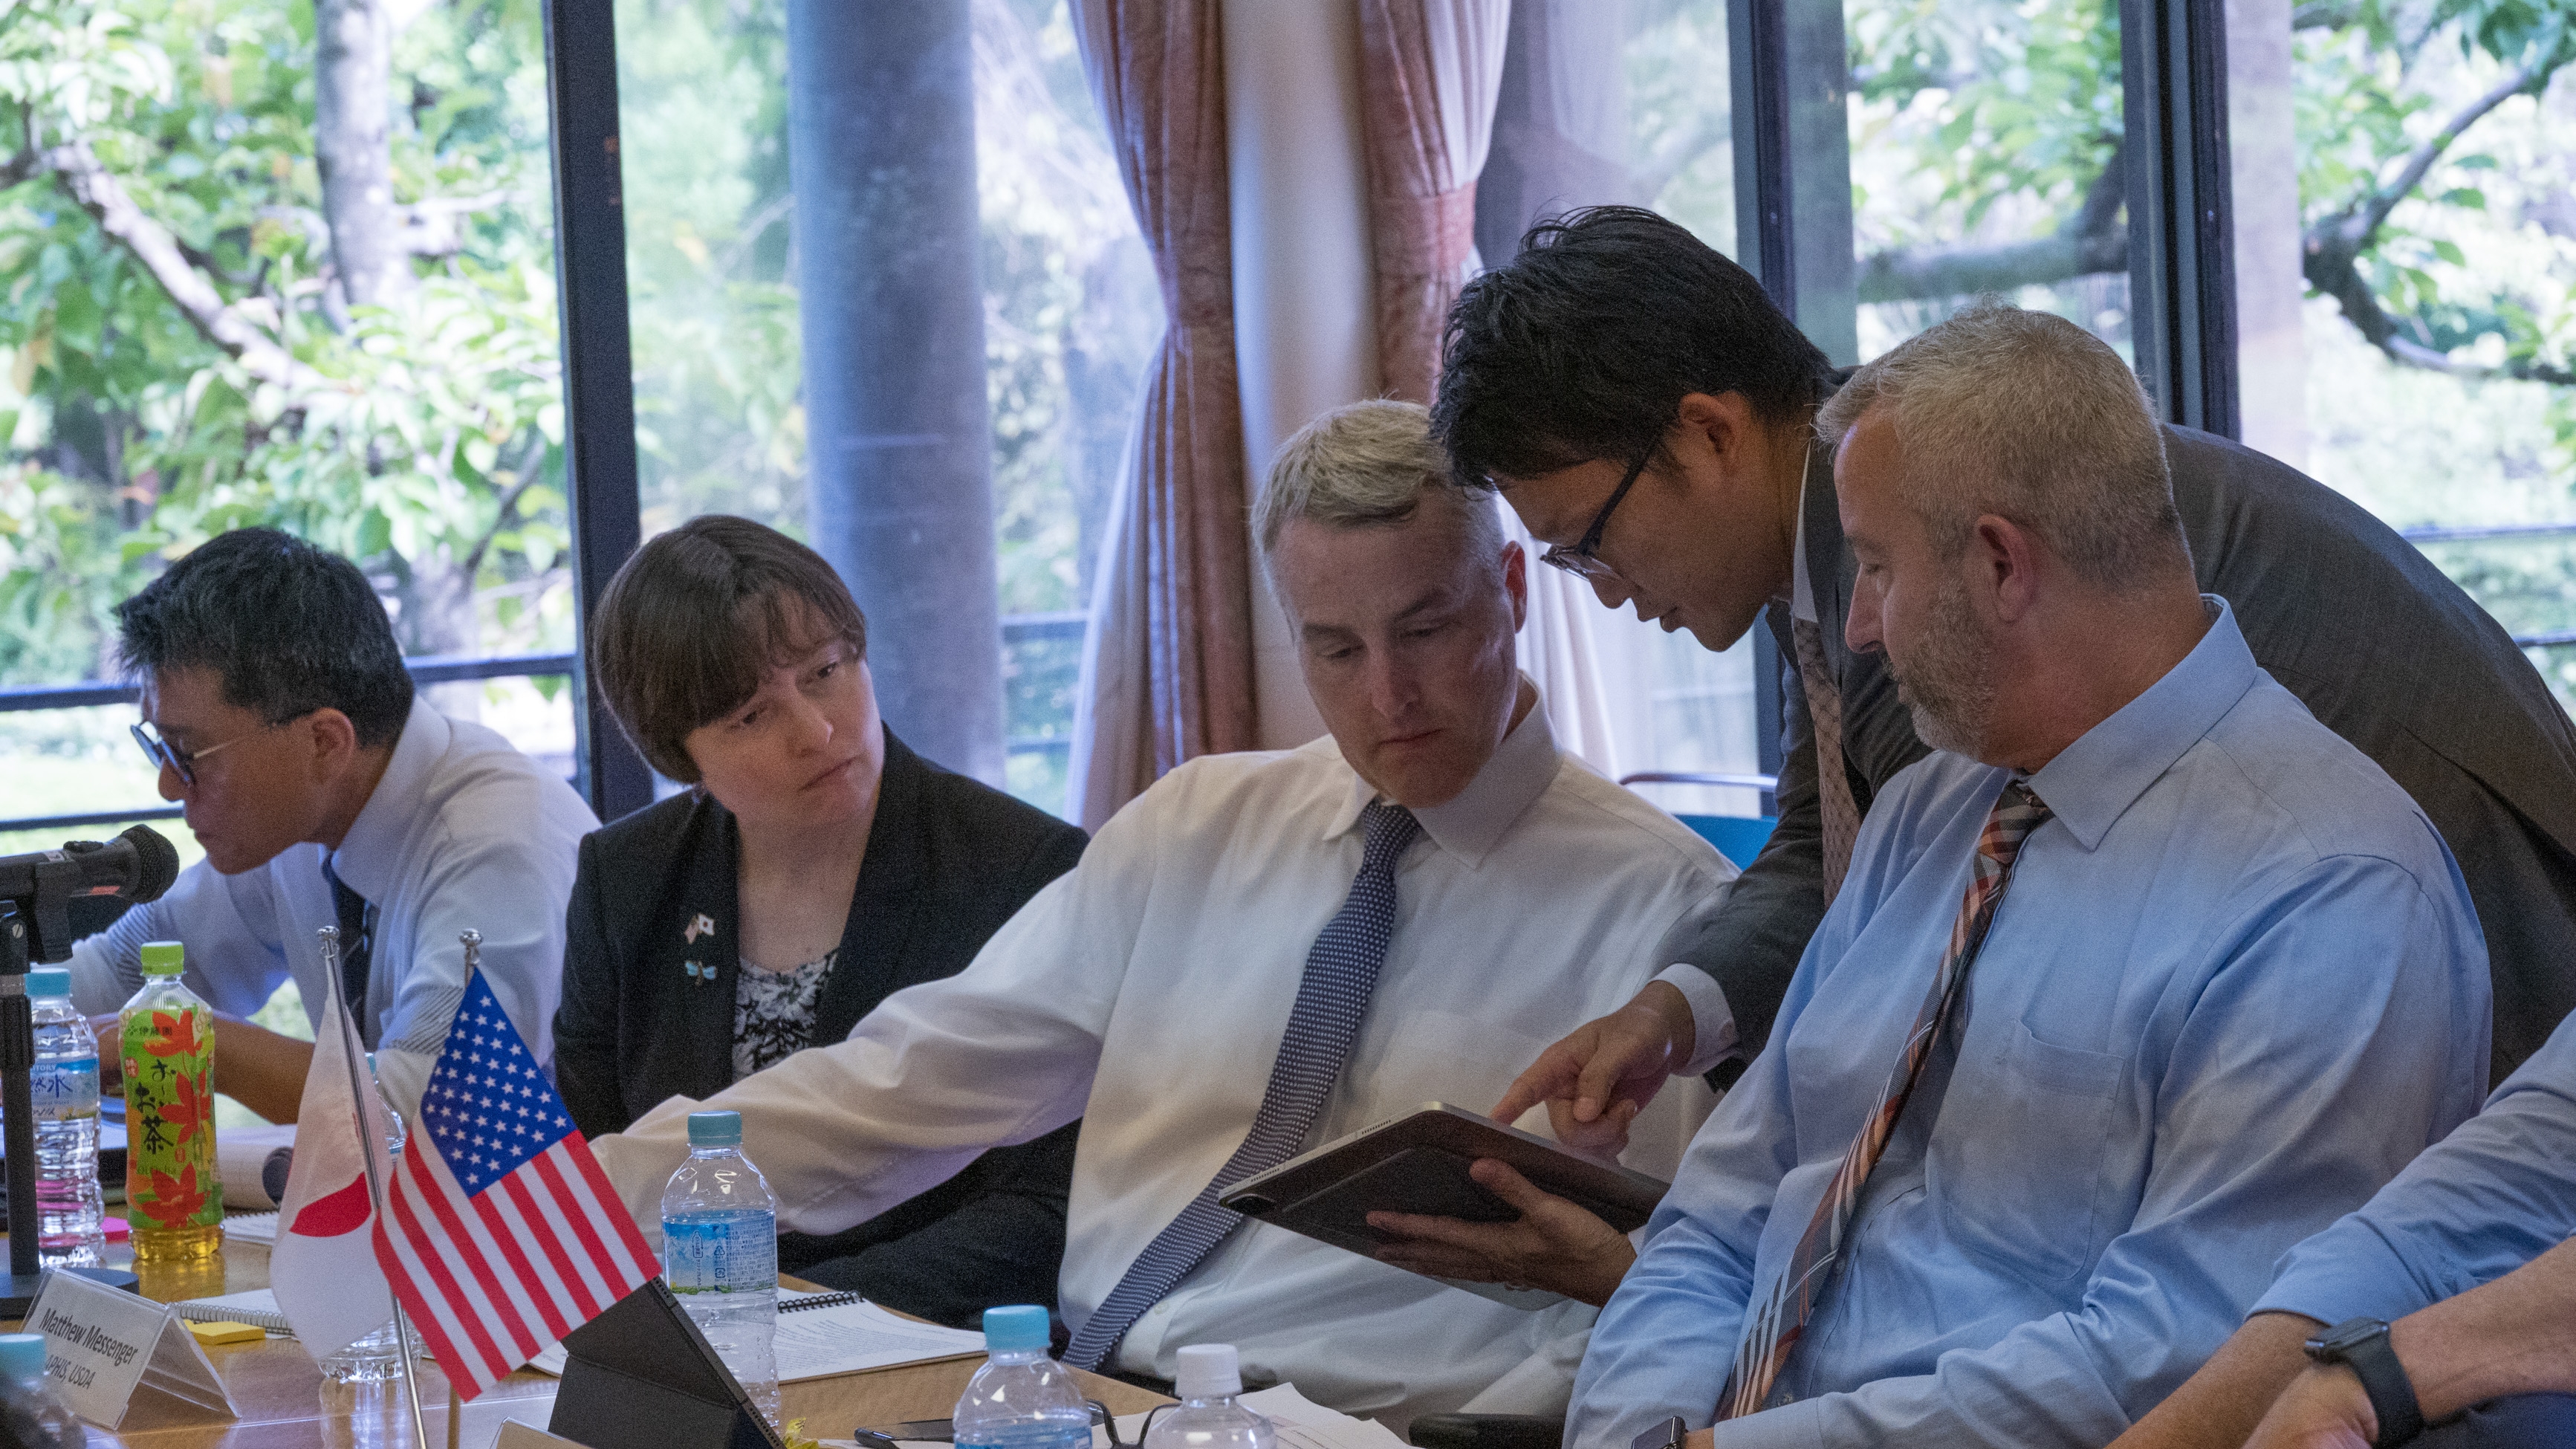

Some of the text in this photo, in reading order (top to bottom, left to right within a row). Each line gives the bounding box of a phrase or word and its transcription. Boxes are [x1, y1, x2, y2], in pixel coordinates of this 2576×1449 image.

[31, 1073, 73, 1098] 然水
[134, 1081, 175, 1155] お茶
[39, 1308, 138, 1367] Matthew Messenger
[68, 1364, 96, 1390] USDA
